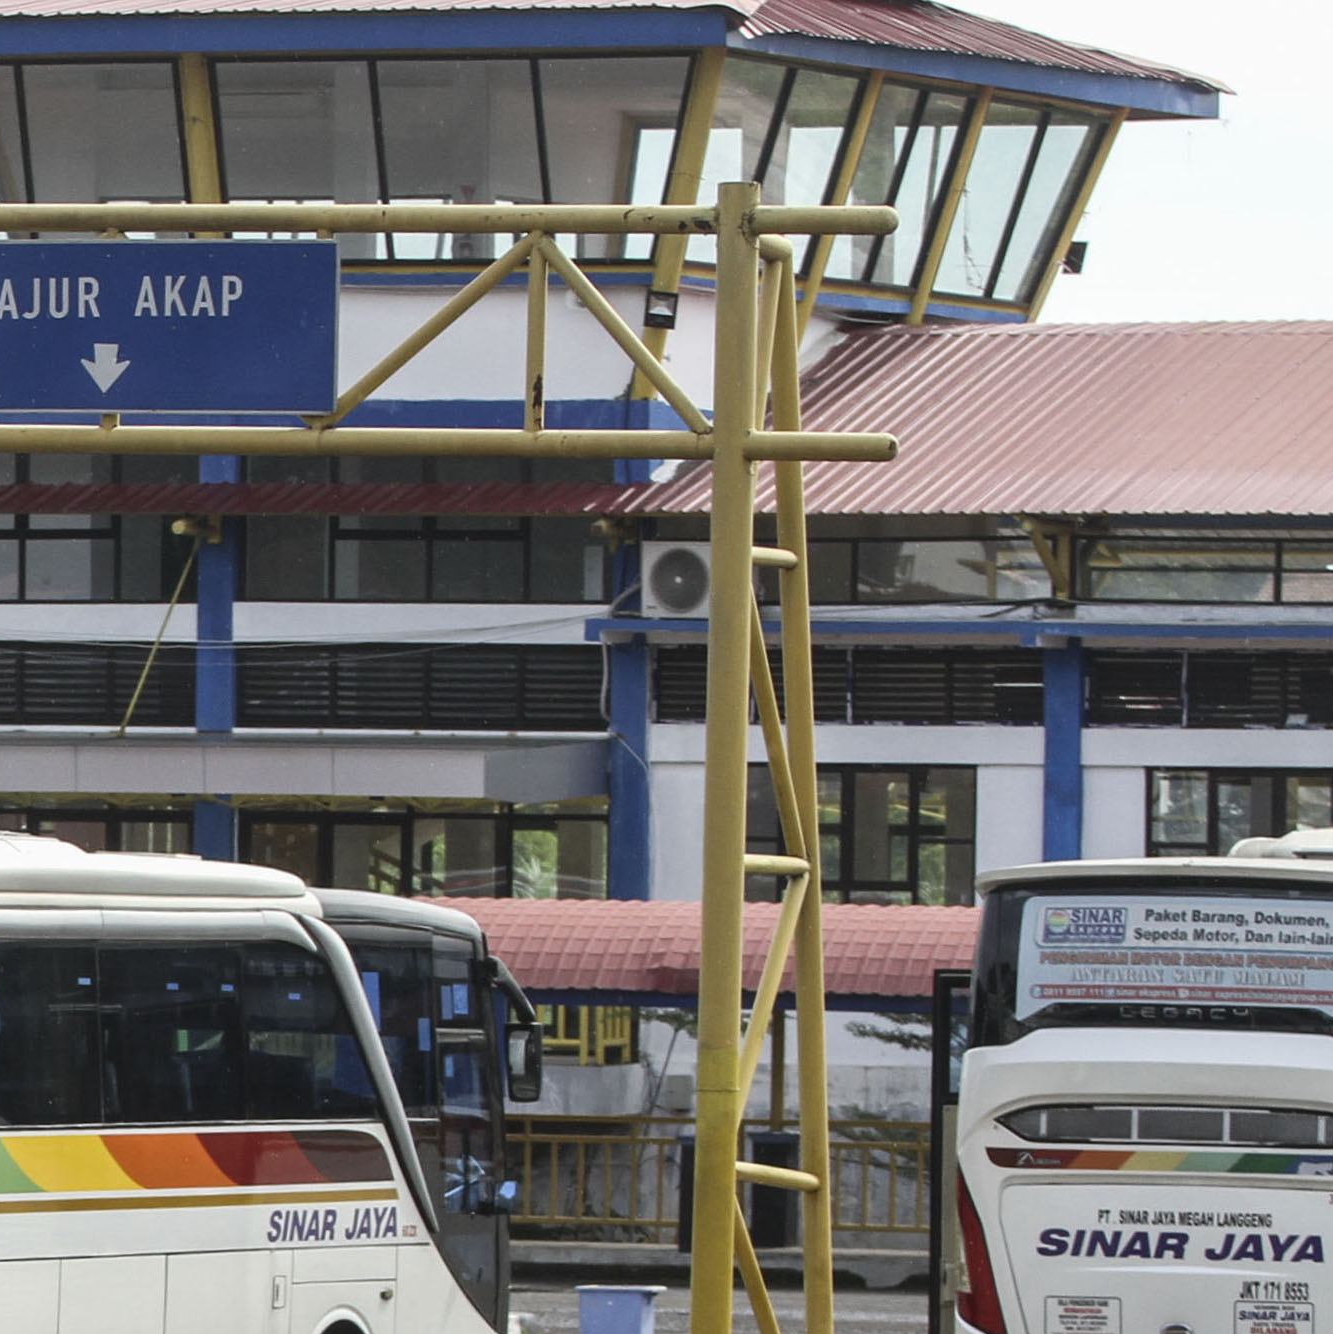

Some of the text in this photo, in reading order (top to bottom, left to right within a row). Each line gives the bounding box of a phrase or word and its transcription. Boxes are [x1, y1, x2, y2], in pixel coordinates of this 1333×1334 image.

[134, 275, 243, 317] AKAP
[1071, 908, 1123, 924] SINAR
[1145, 909, 1330, 928] Paket Barang, Dokumen,
[1134, 927, 1187, 942] Sepeda
[1193, 928, 1240, 944] Motor,
[1245, 930, 1273, 943] Dan
[267, 1207, 397, 1242] SINAR JAYA
[1119, 1210, 1149, 1225] SINAR
[1151, 1211, 1176, 1225] JAYA
[1178, 1212, 1214, 1226] MEGAH
[1216, 1213, 1273, 1228] LANGGENG
[1036, 1228, 1325, 1262] SINAR JAYA
[1239, 1281, 1260, 1299] JKT
[1263, 1282, 1281, 1300] 171
